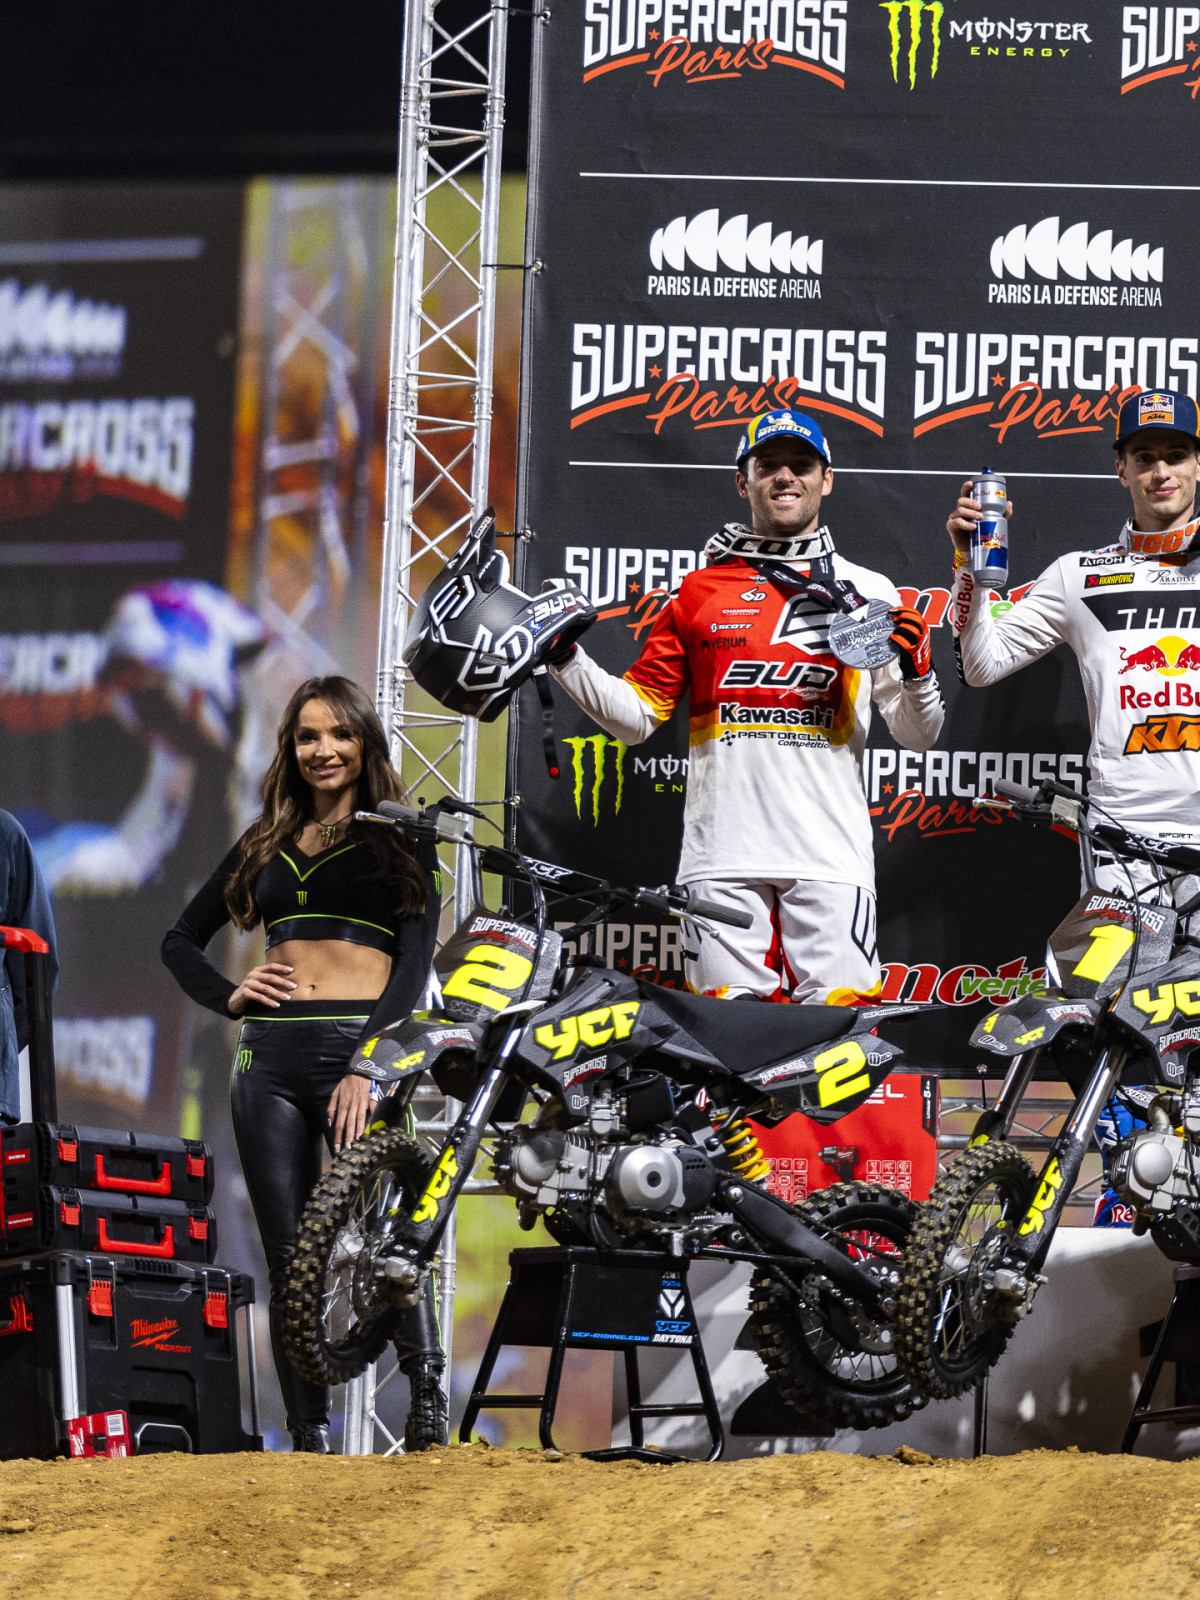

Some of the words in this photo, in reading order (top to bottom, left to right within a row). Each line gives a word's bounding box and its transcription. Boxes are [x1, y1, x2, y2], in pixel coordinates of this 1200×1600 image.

[583, 0, 848, 74] SUPERCROSS
[949, 17, 1093, 45] MONSTER
[646, 36, 775, 88] Paris
[970, 46, 1070, 58] ENERGY
[647, 275, 691, 296] PARIS
[693, 276, 711, 297] LA
[713, 277, 777, 298] DEFENSE
[779, 279, 822, 300] ARENA
[988, 283, 1031, 304] PARIS
[1033, 284, 1050, 304] LA
[1053, 285, 1118, 306] DEFENSE
[1120, 286, 1162, 307] ARENA
[571, 322, 888, 419] SUPERCROSS
[646, 372, 800, 435] Paris
[1141, 403, 1156, 413] Red
[1157, 402, 1173, 412] Bull
[758, 424, 811, 439] MICHELIN
[1131, 518, 1200, 553] 100%
[740, 587, 767, 602] 6D
[957, 572, 975, 602] Bull
[954, 602, 970, 633] Red
[710, 636, 747, 650] VENUM
[719, 660, 838, 691] BUD
[1120, 682, 1169, 710] Red
[719, 702, 835, 730] Kawasaki
[863, 748, 1089, 803] PERCROSS
[1087, 894, 1167, 935] SUPERCROSS
[468, 916, 551, 958] SUPERCROSS
[1072, 923, 1136, 983] 1
[441, 944, 534, 1011] 2
[961, 975, 1046, 997] verte
[535, 1001, 641, 1060] YCF
[1014, 1026, 1046, 1046] YCF
[393, 1051, 425, 1070] YCF
[563, 1055, 608, 1087] SUPERCROSS
[759, 1059, 808, 1085] SUPERCROSS
[813, 1041, 871, 1109] 2
[412, 1144, 459, 1223] YCF
[1019, 1156, 1064, 1236] YCF
[1112, 1203, 1133, 1223] Re
[131, 1317, 179, 1340] Milwaukee
[571, 1331, 650, 1342] YCF-RIDING.COM
[652, 1333, 693, 1344] DAYTONA
[655, 1320, 691, 1333] YCF
[155, 1343, 192, 1354] PACKOUT
